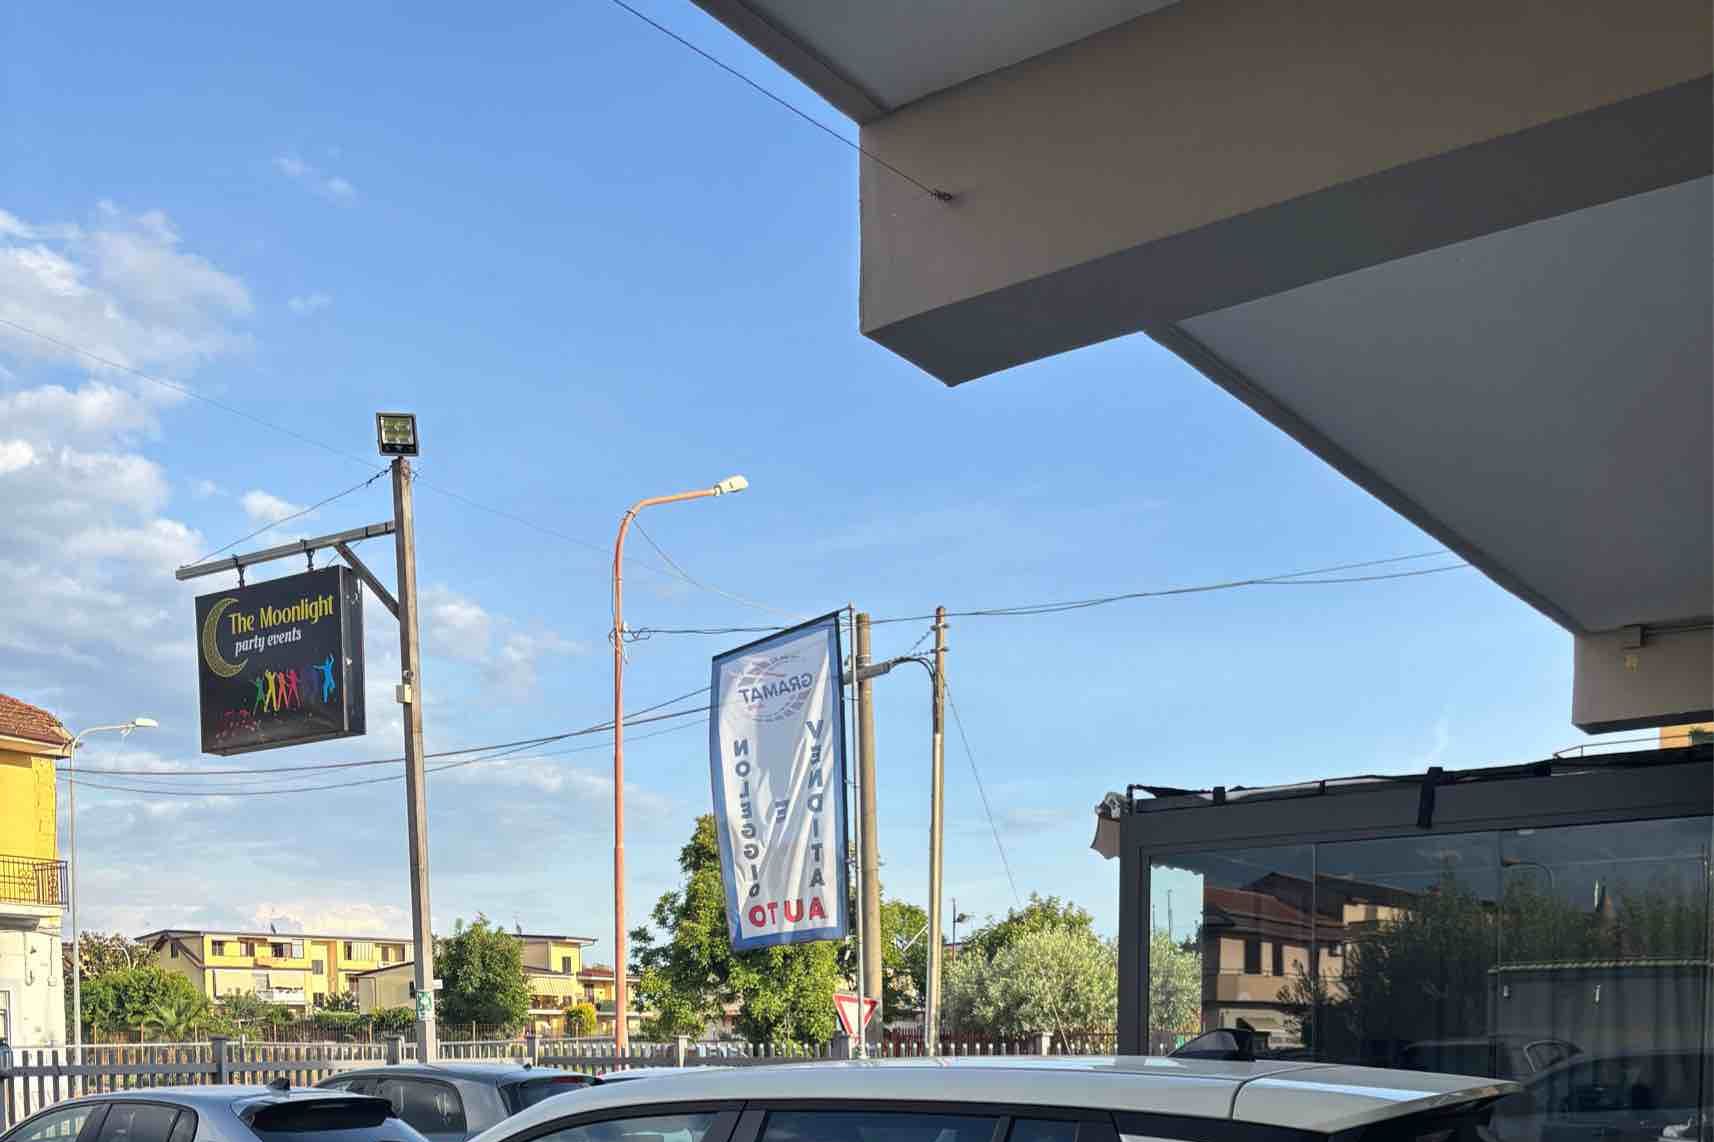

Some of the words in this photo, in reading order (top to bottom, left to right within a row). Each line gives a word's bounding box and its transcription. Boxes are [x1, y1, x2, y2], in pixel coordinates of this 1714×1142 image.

[228, 612, 255, 635] The
[259, 594, 334, 625] Moonlight
[234, 634, 265, 657] party
[267, 627, 302, 647] events
